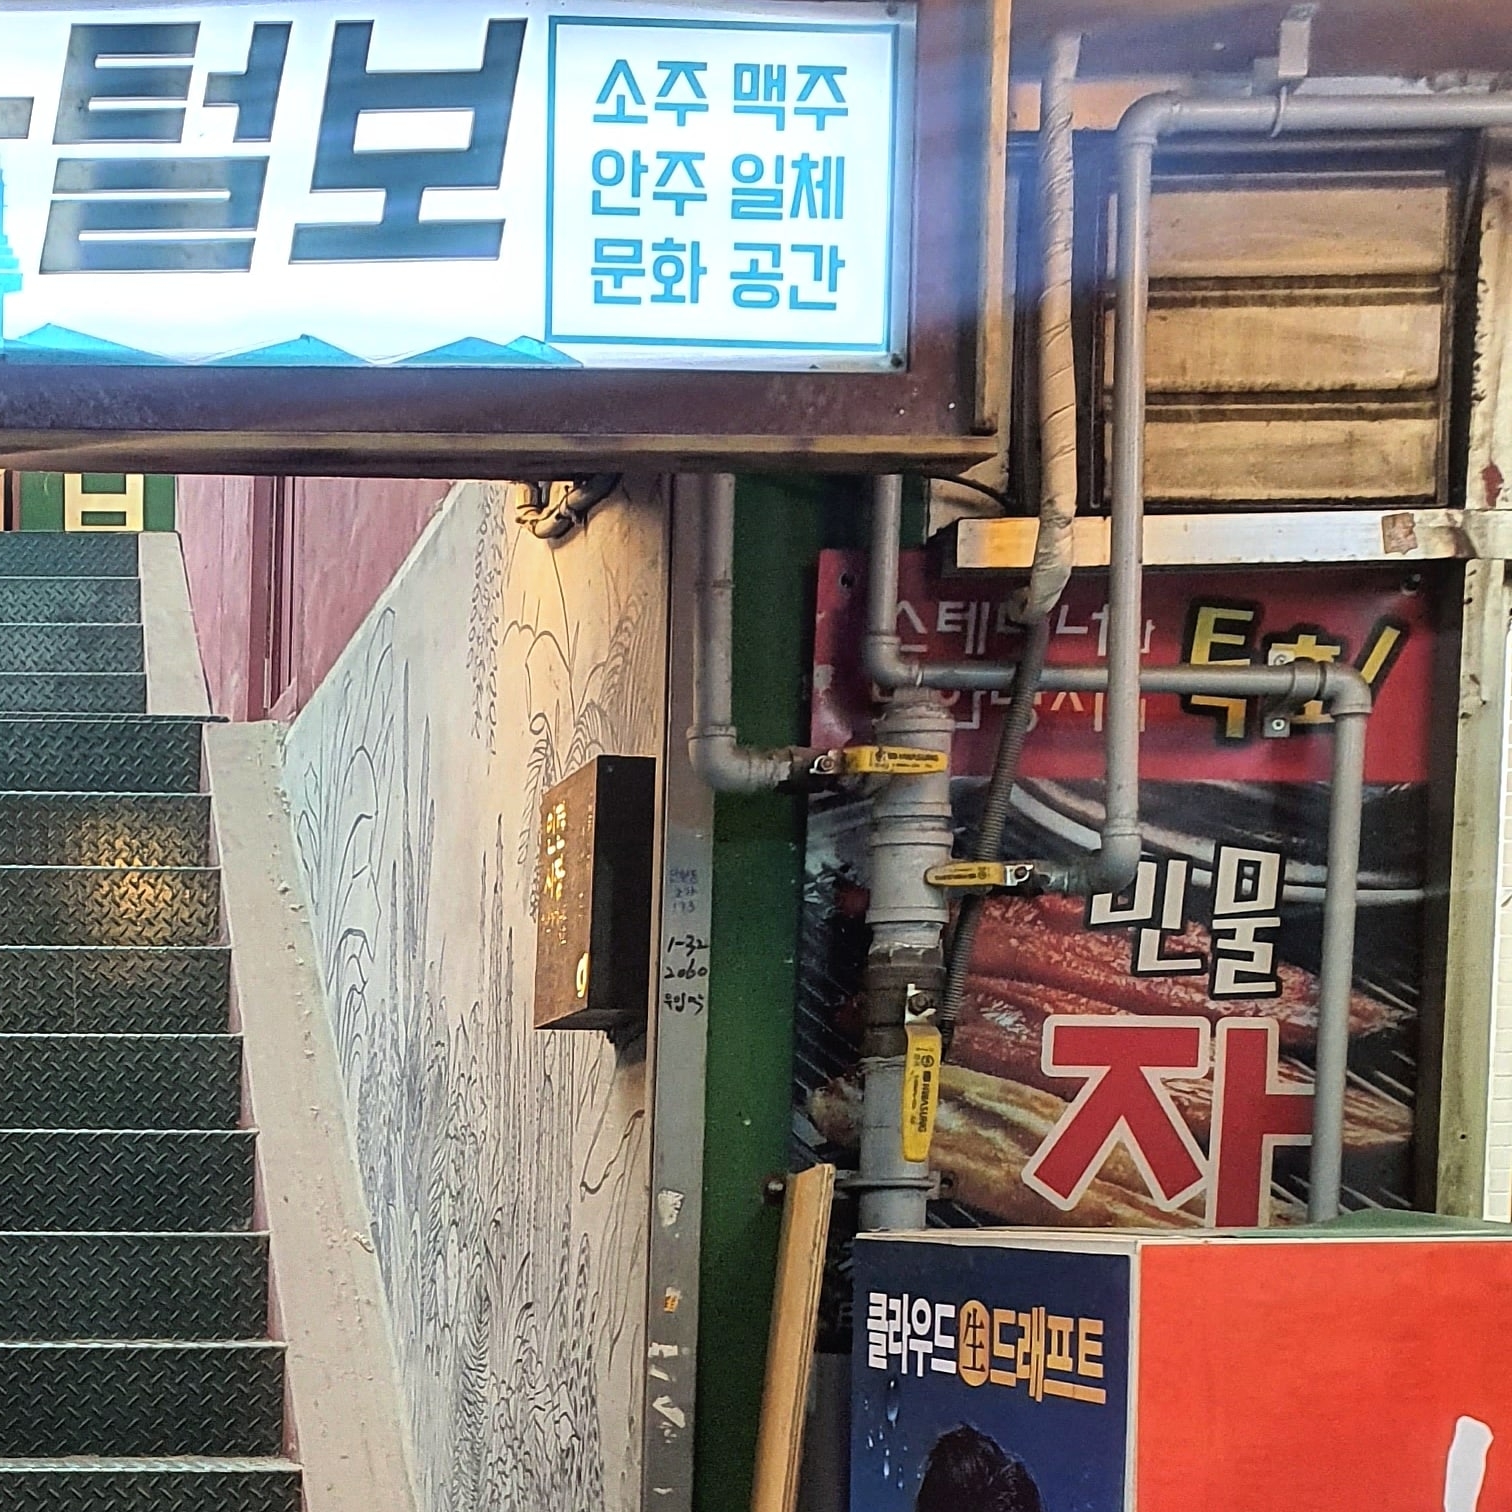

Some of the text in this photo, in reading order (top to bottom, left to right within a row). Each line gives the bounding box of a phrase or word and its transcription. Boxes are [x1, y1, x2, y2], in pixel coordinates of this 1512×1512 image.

[592, 58, 849, 132] 소주 맥주
[590, 148, 846, 220] 안주 일체
[590, 237, 846, 311] 문화 공간
[1088, 847, 1284, 995] 민물
